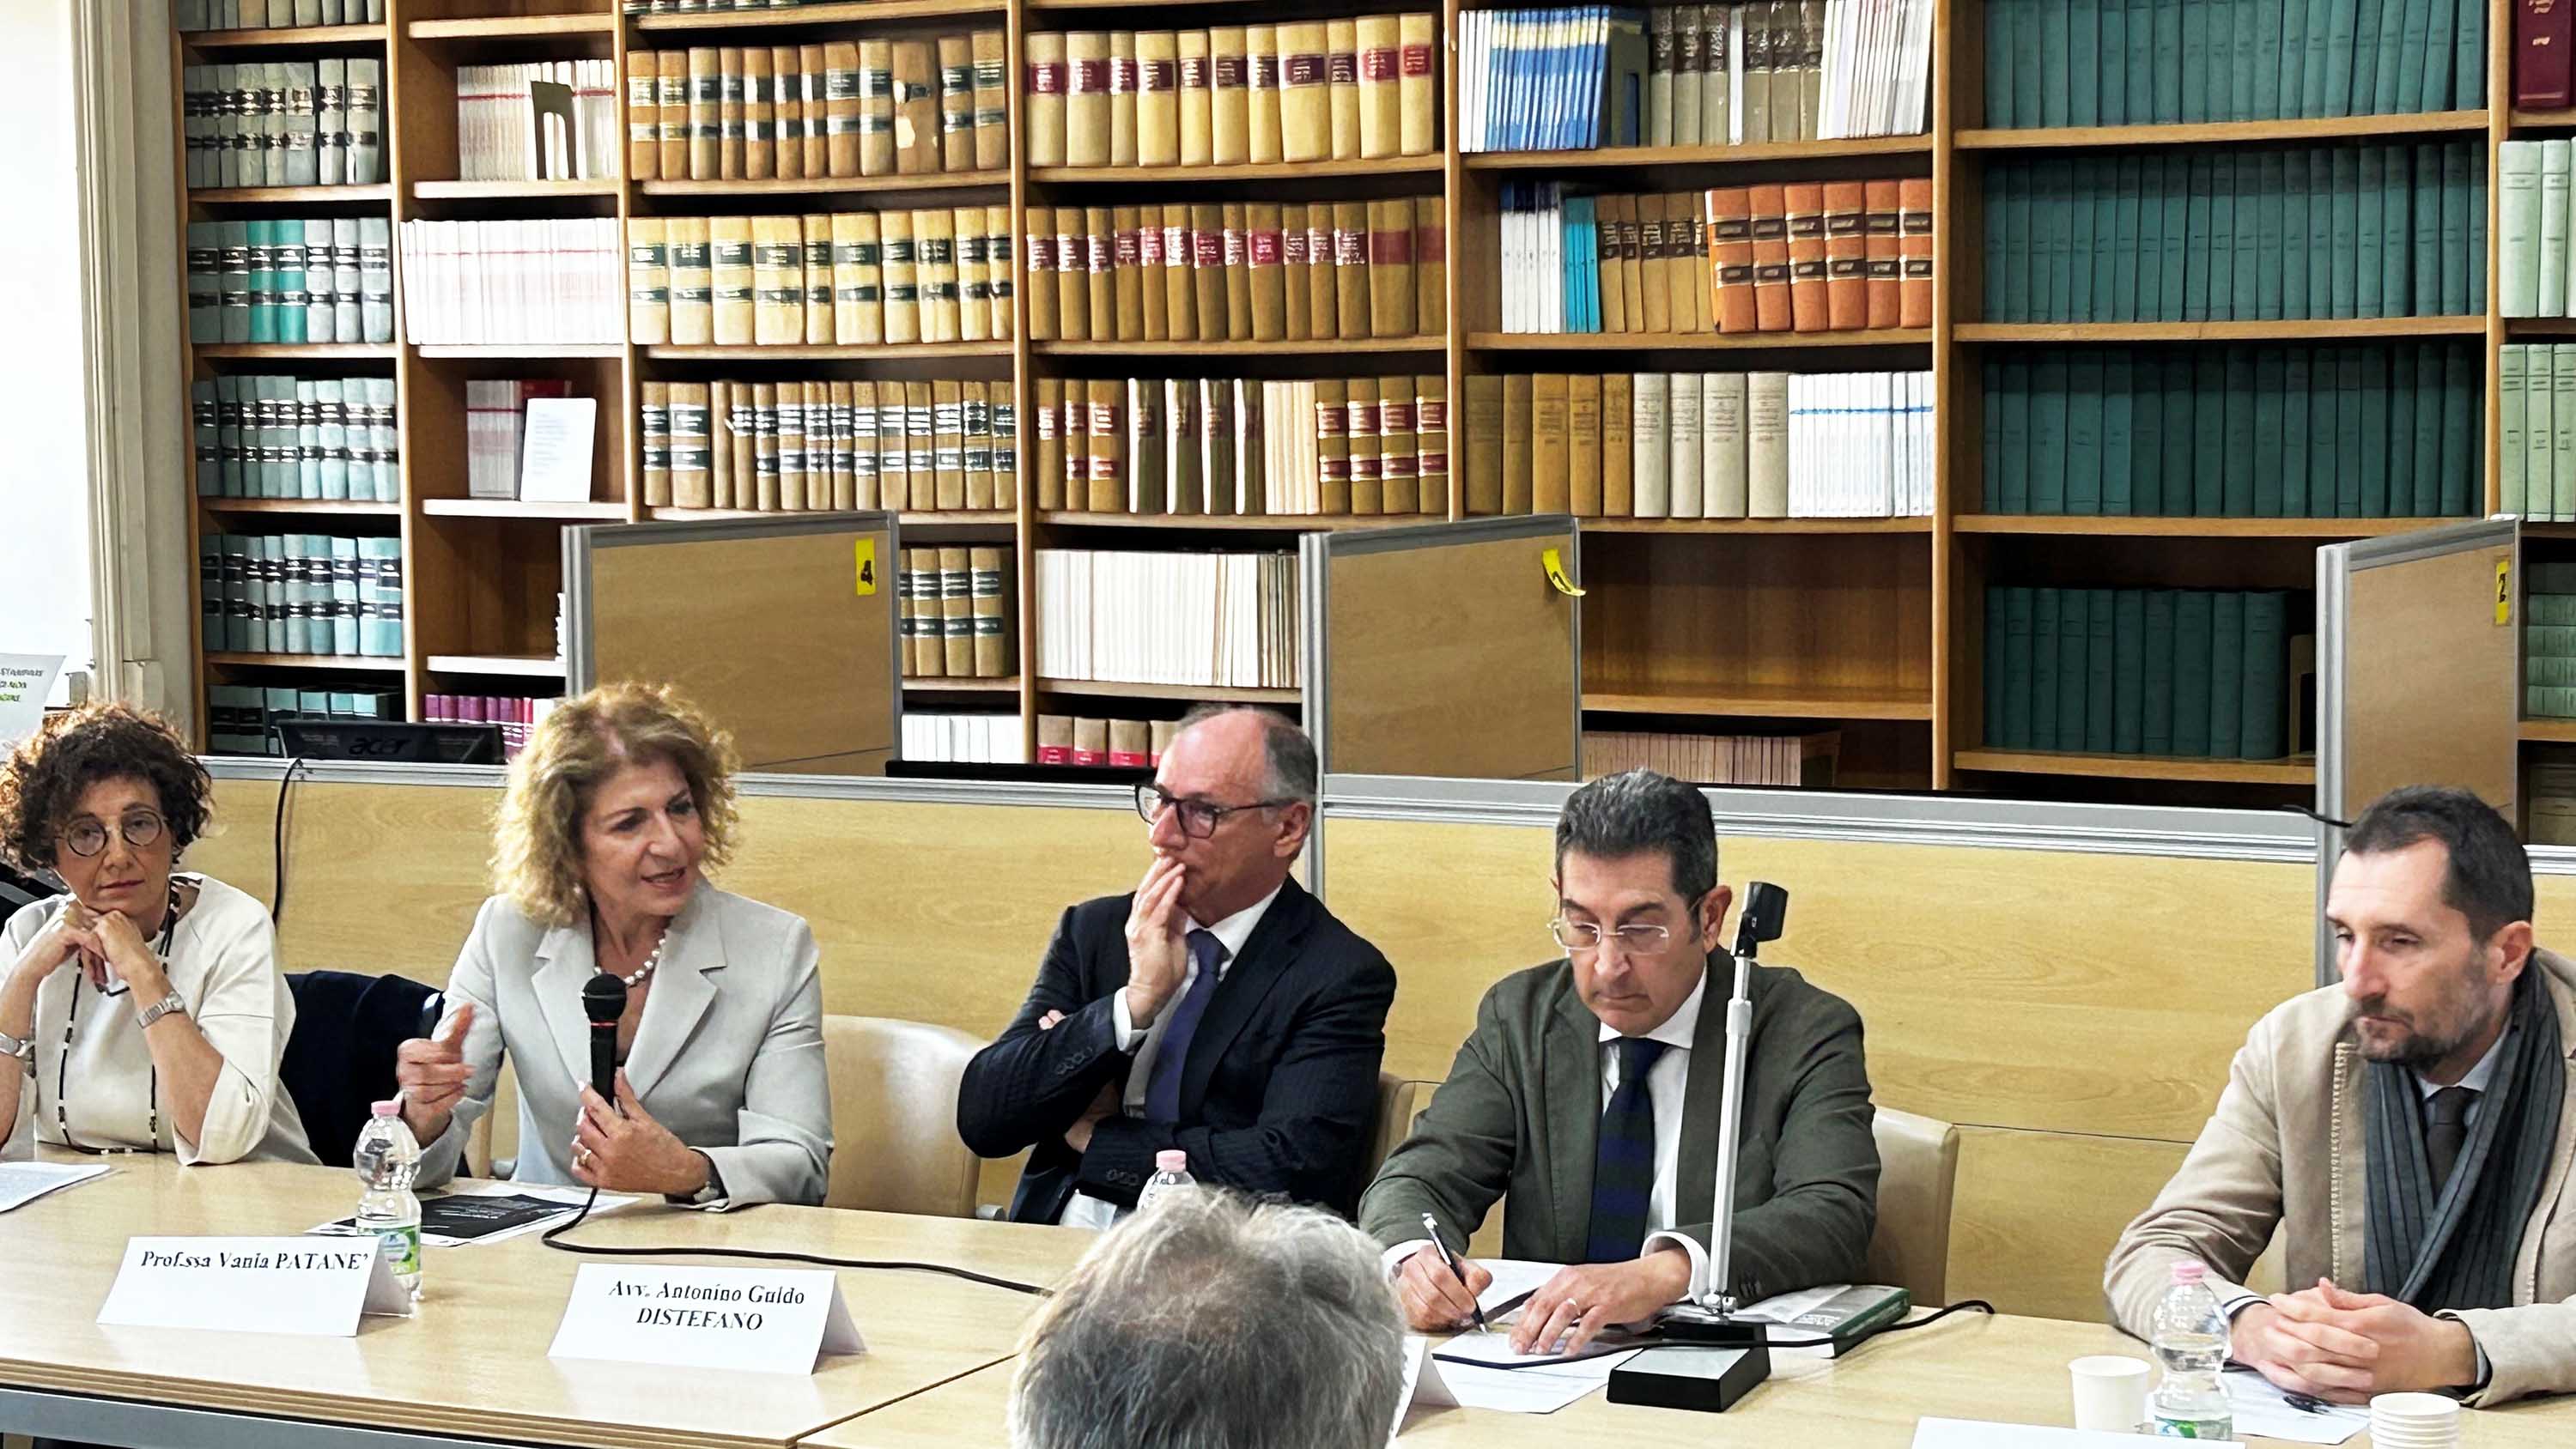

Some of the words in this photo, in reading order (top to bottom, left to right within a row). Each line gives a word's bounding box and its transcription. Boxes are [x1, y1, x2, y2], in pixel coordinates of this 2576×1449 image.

[349, 737, 411, 755] acer
[141, 1251, 211, 1269] Prof.ssa
[219, 1252, 269, 1269] Vania
[609, 1280, 651, 1297] Avv.
[656, 1282, 742, 1302] Antonino
[748, 1284, 805, 1305] Guido
[635, 1307, 763, 1331] DISTEFANO
